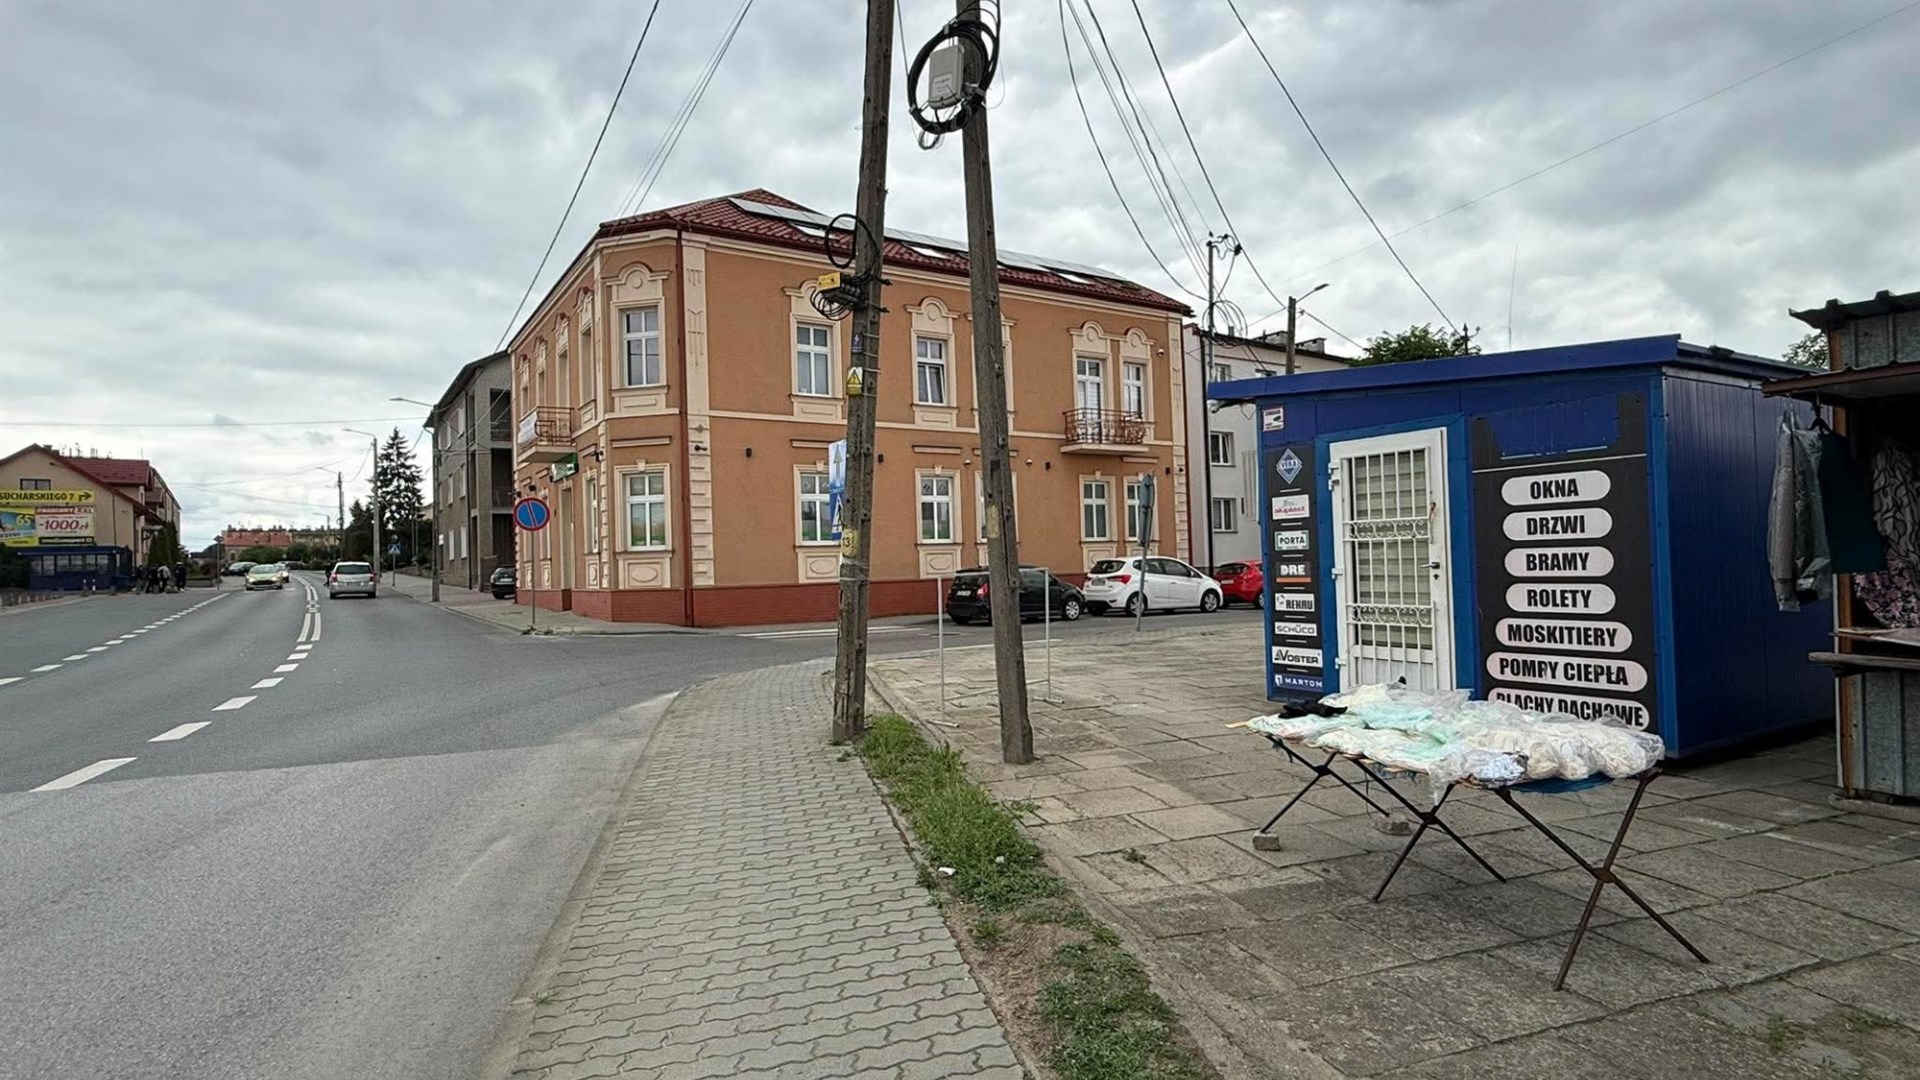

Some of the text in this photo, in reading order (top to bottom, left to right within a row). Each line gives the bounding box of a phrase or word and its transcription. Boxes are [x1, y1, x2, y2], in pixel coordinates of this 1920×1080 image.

[1281, 460, 1297, 469] VEKA
[1530, 479, 1579, 499] OKNA
[0, 492, 75, 501] SUCHARSKIEGO 7
[1526, 515, 1585, 535] DRZWI
[1279, 536, 1305, 545] PORTA
[1526, 552, 1589, 571] BRAMY
[1280, 564, 1306, 576] DRE
[1286, 599, 1313, 610] REHAU
[1527, 589, 1592, 608] ROLETY
[1276, 624, 1315, 634] SCHÜCO
[1507, 624, 1617, 647] MOSKITIERY
[1499, 657, 1628, 685] POMPY CIEPŁA
[1285, 678, 1323, 688] MARTOM
